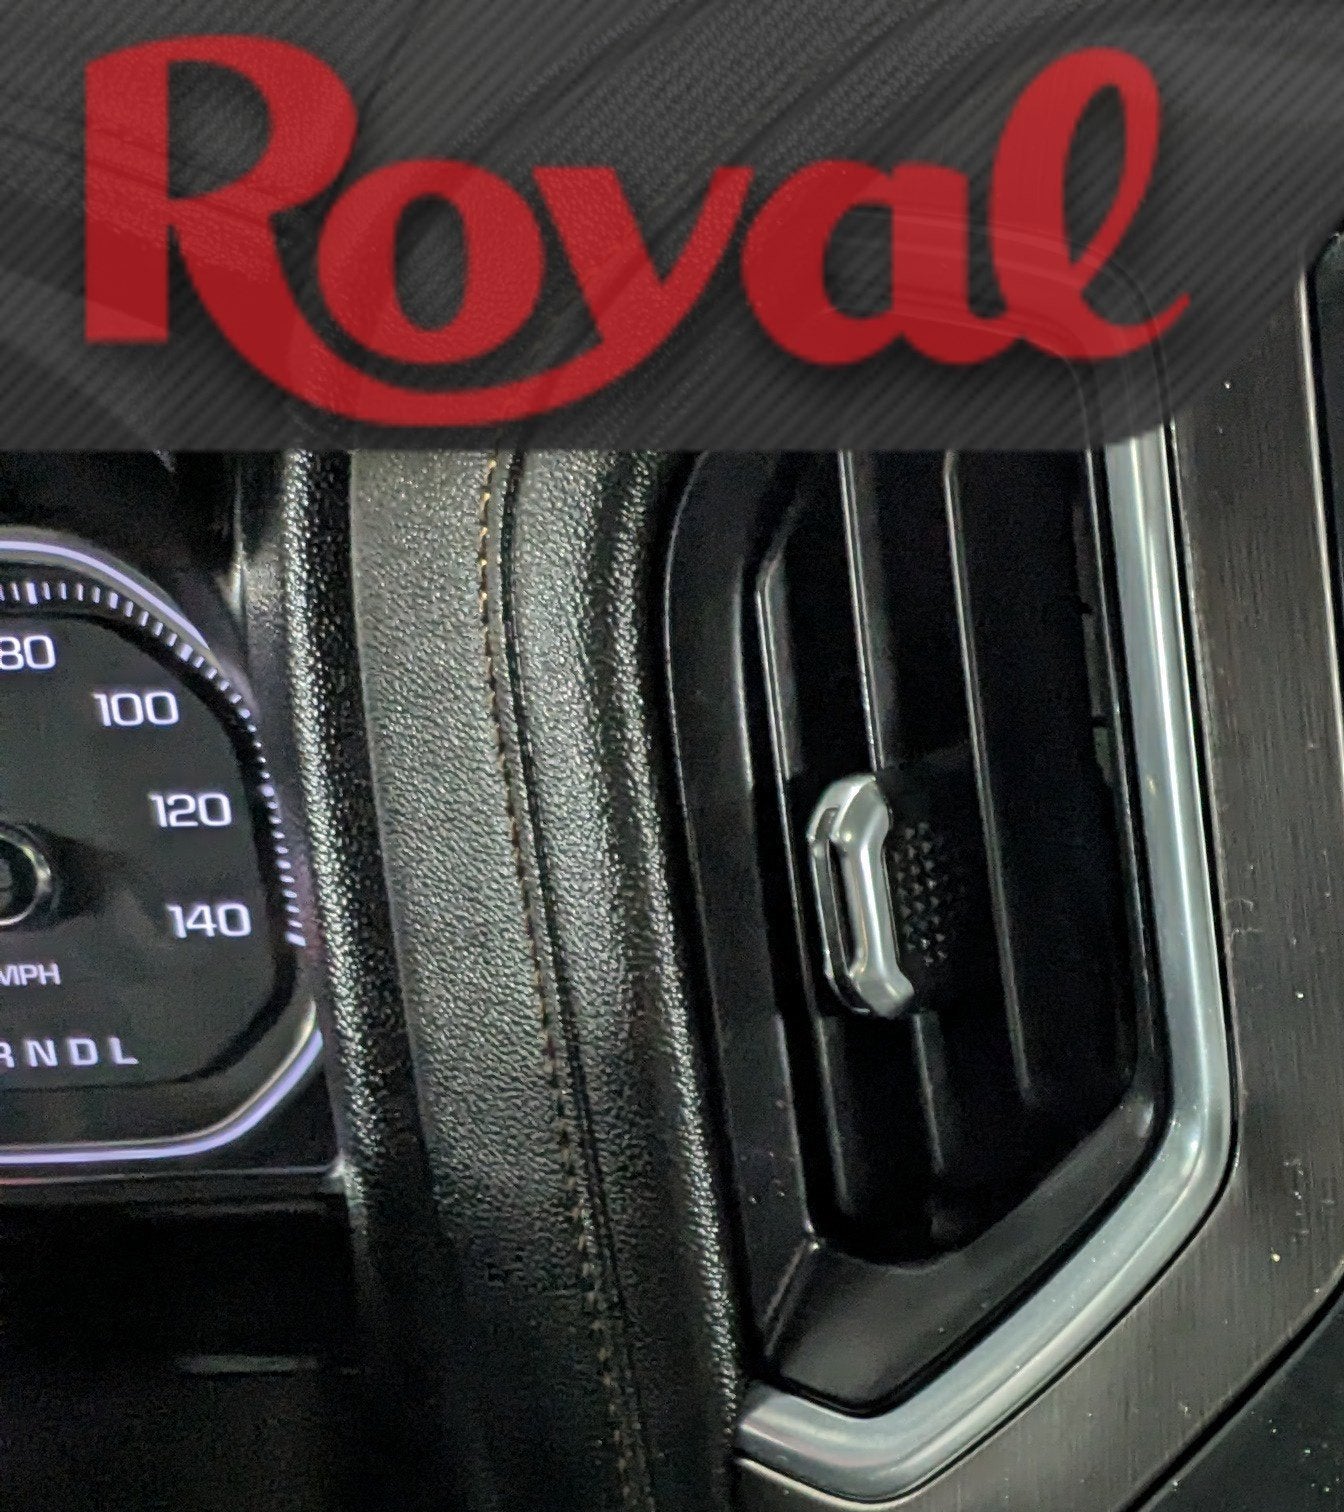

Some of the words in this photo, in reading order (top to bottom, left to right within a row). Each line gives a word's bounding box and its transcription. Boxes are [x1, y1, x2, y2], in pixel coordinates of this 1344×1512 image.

[93, 690, 179, 727] 100
[149, 792, 232, 828] 120
[166, 902, 252, 939] 140
